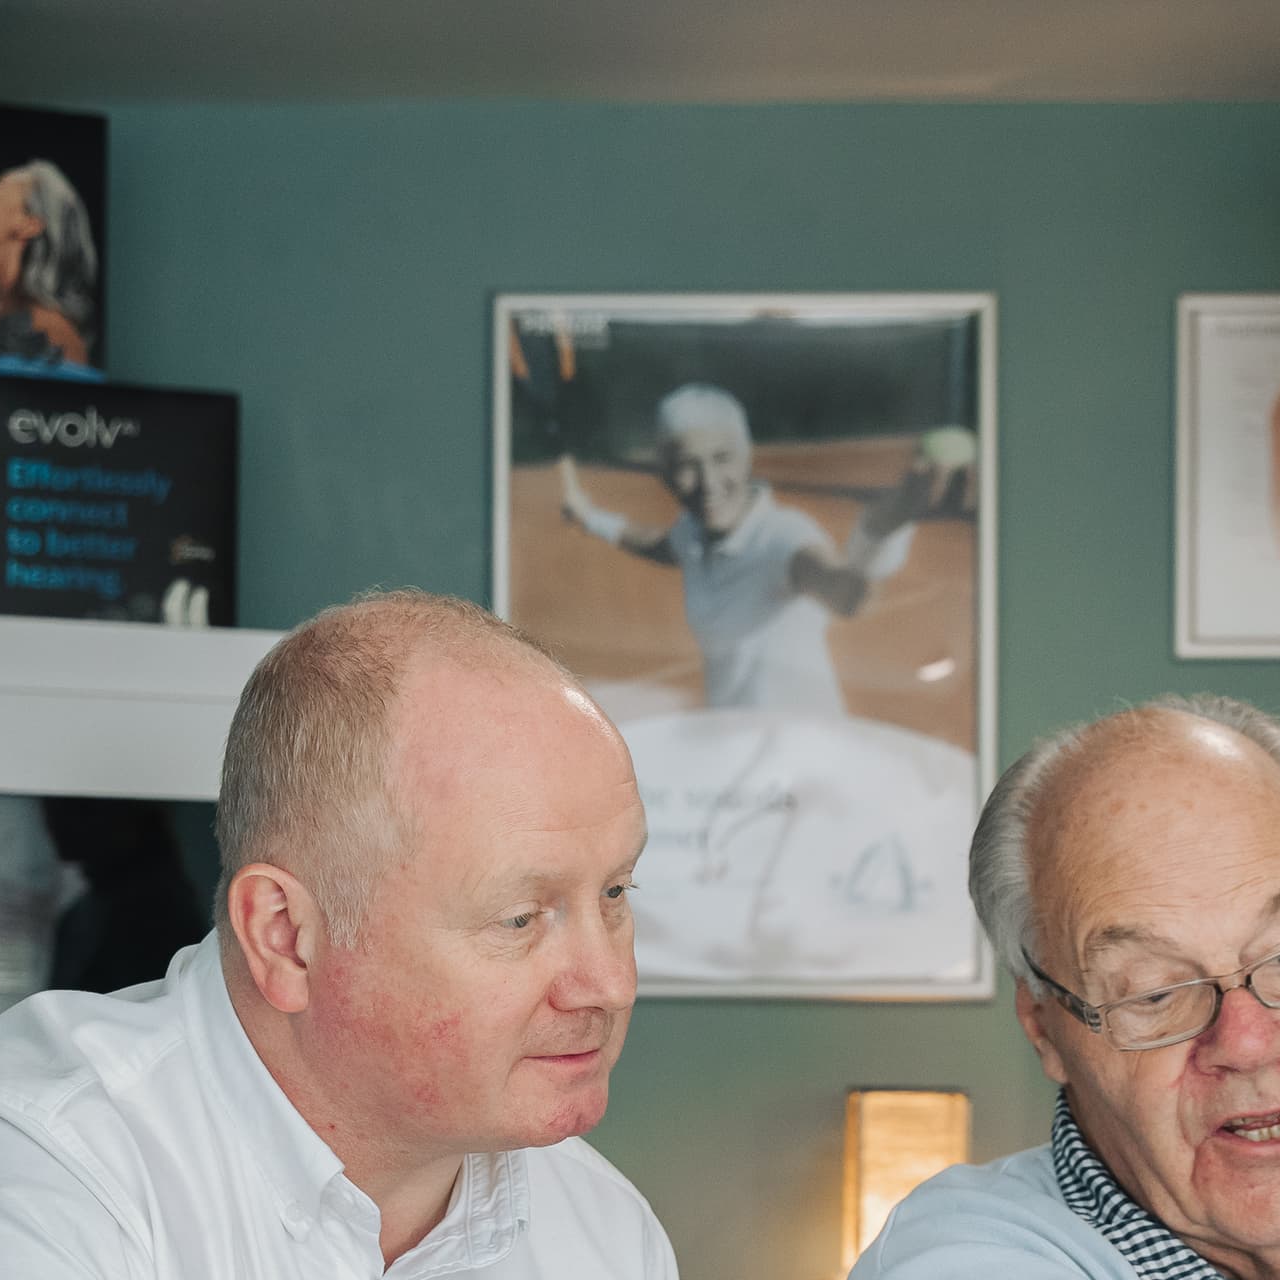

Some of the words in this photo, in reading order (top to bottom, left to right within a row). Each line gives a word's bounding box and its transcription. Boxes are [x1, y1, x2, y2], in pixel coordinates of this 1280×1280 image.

[8, 404, 121, 449] evolv
[6, 496, 128, 528] connect
[6, 527, 42, 556] to
[45, 527, 140, 560] better
